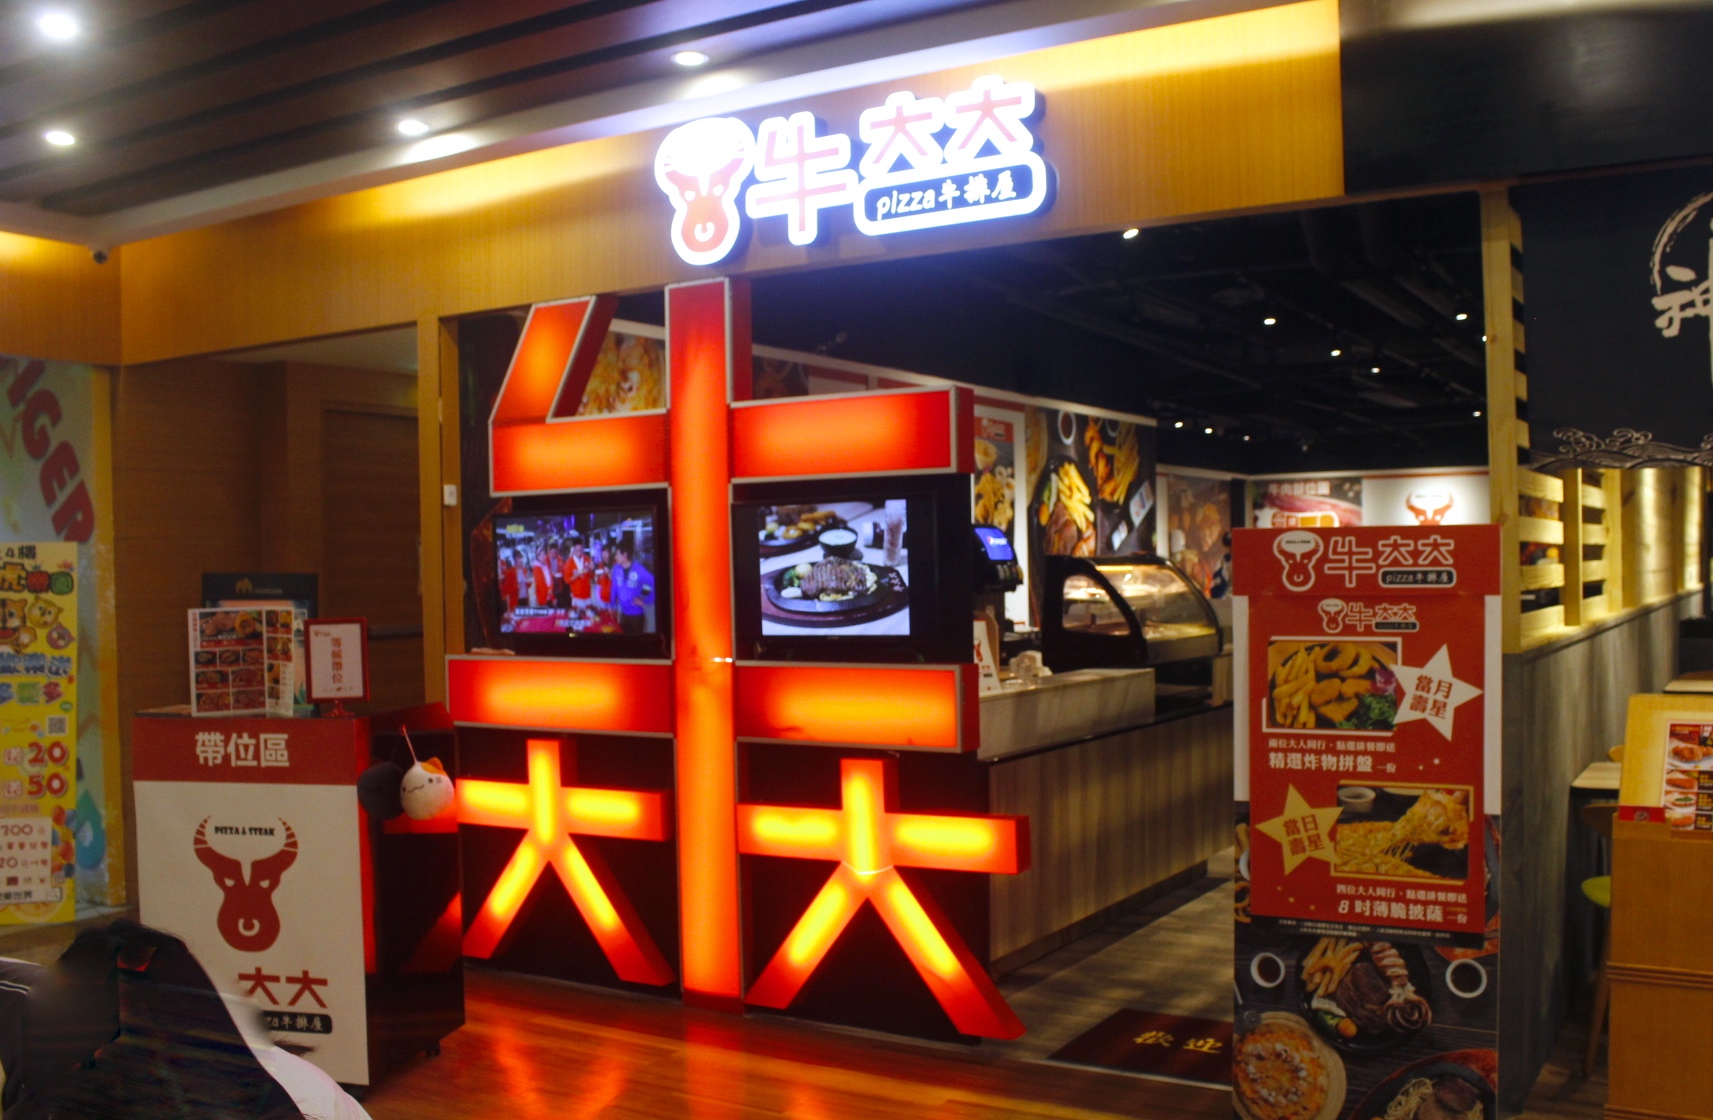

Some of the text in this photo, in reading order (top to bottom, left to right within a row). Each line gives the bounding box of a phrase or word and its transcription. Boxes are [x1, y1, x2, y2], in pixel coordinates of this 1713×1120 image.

[0, 357, 95, 542] IGER
[1325, 535, 1454, 588] 牛大大
[195, 731, 290, 767] 帶位區
[1269, 752, 1374, 773] 精選炸物拼盤
[248, 827, 275, 836] STEAK
